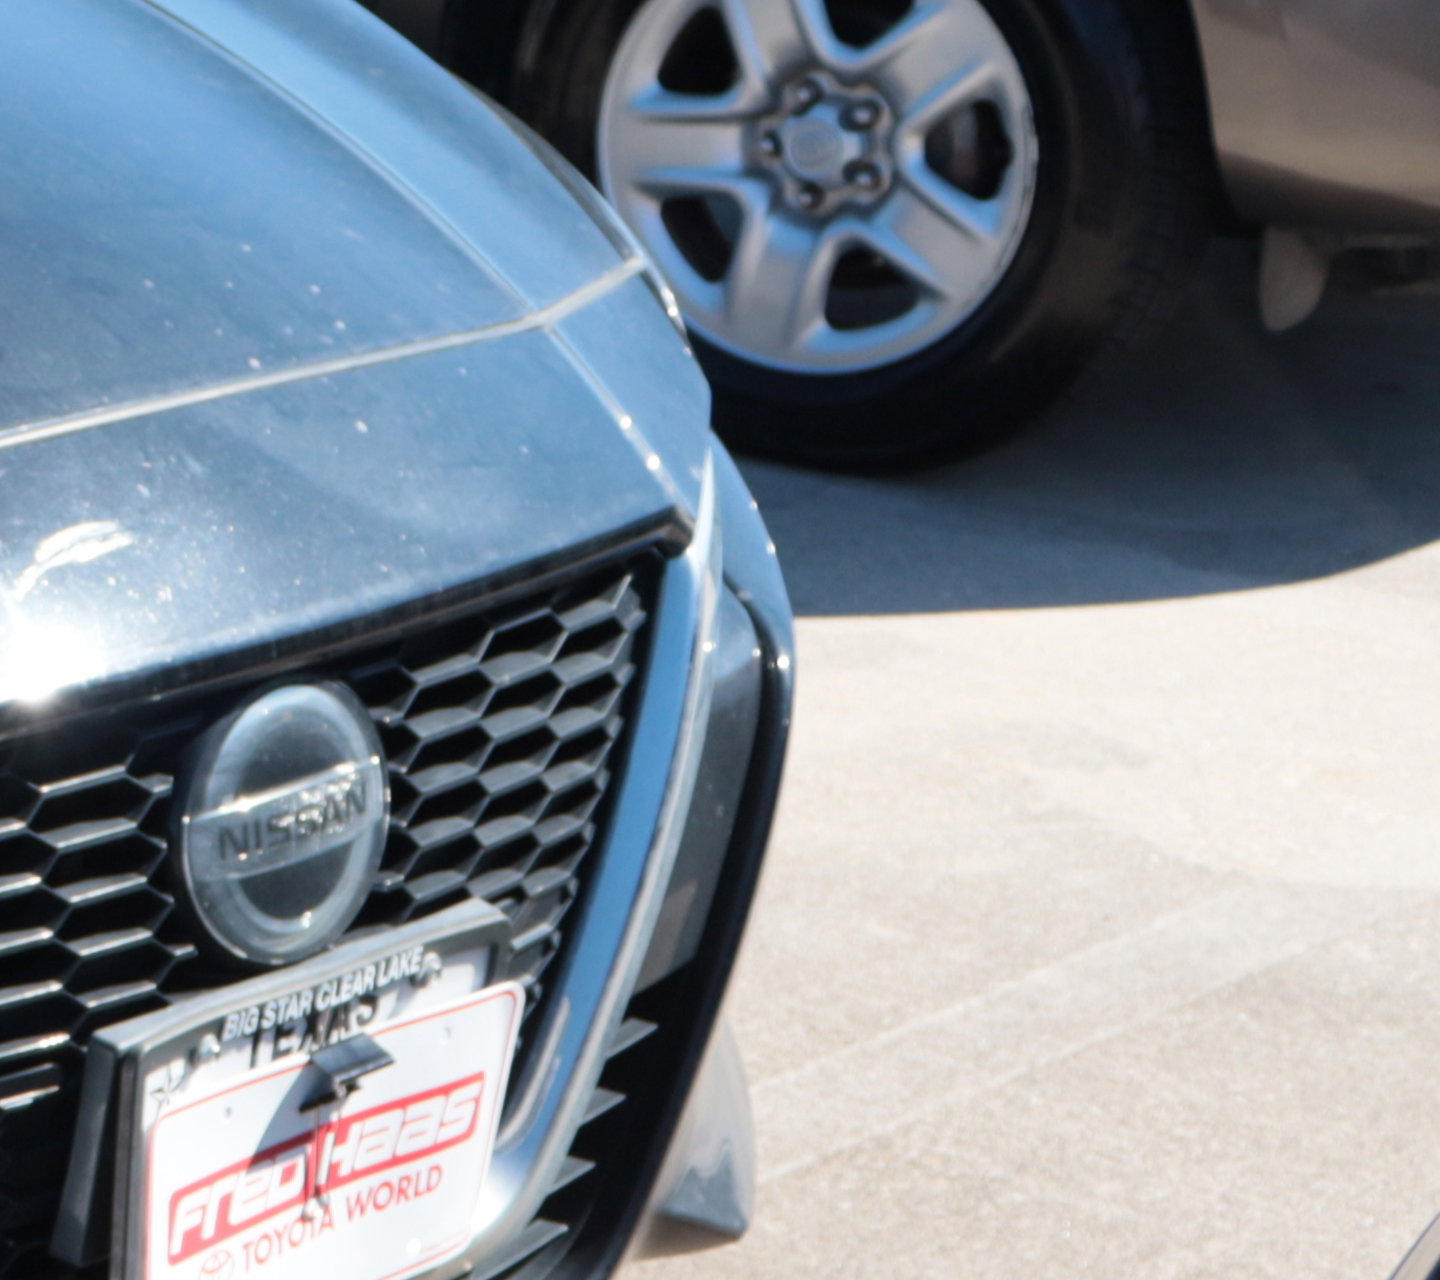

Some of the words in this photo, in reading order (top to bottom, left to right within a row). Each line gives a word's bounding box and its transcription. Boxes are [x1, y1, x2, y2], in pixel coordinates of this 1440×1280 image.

[218, 777, 368, 861] NISSAN
[221, 1005, 261, 1042] BIG
[261, 987, 314, 1030] STAR
[315, 962, 377, 1012] CLEAR
[376, 945, 425, 988] LAKE
[242, 1204, 335, 1272] TOYOTA
[345, 1165, 444, 1223] WORLD
